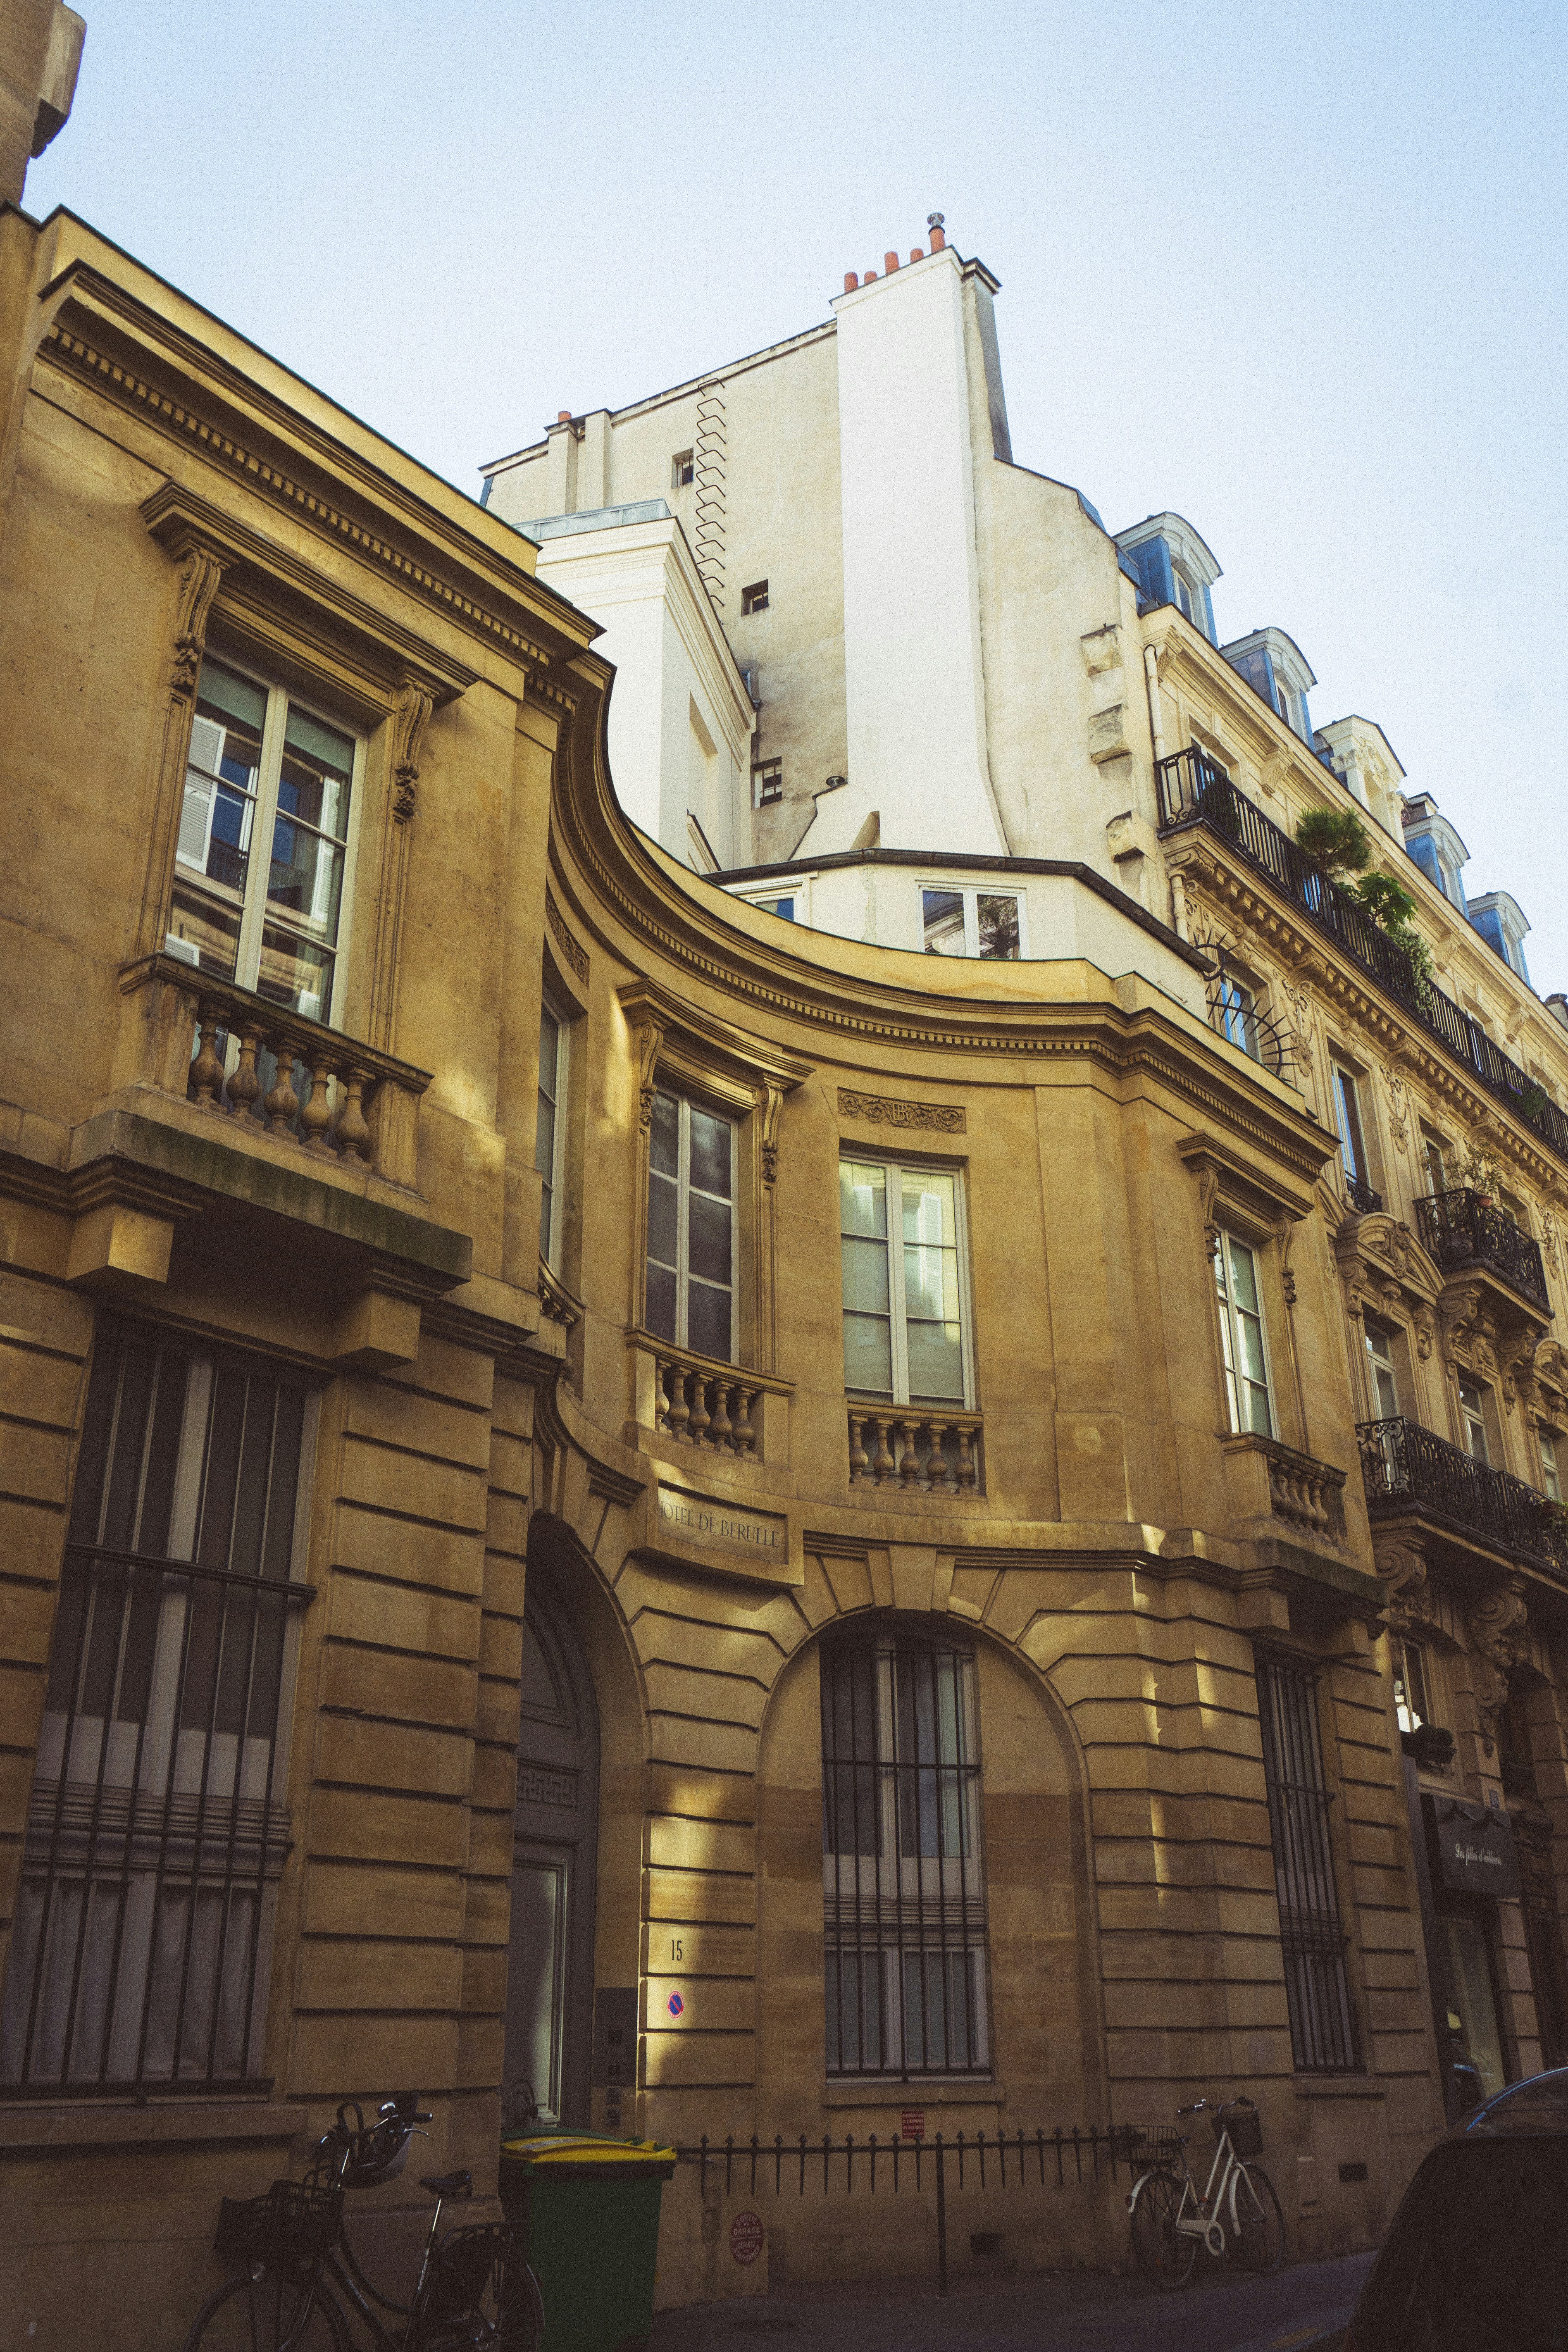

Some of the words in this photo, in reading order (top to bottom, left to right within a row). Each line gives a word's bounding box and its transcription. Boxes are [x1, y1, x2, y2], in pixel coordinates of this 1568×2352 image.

[698, 1513, 716, 1534] DE
[721, 1519, 779, 1548] BERULLE
[671, 1940, 682, 1961] 15
[735, 2214, 758, 2226] SORTIE
[733, 2226, 760, 2235] GARAGE
